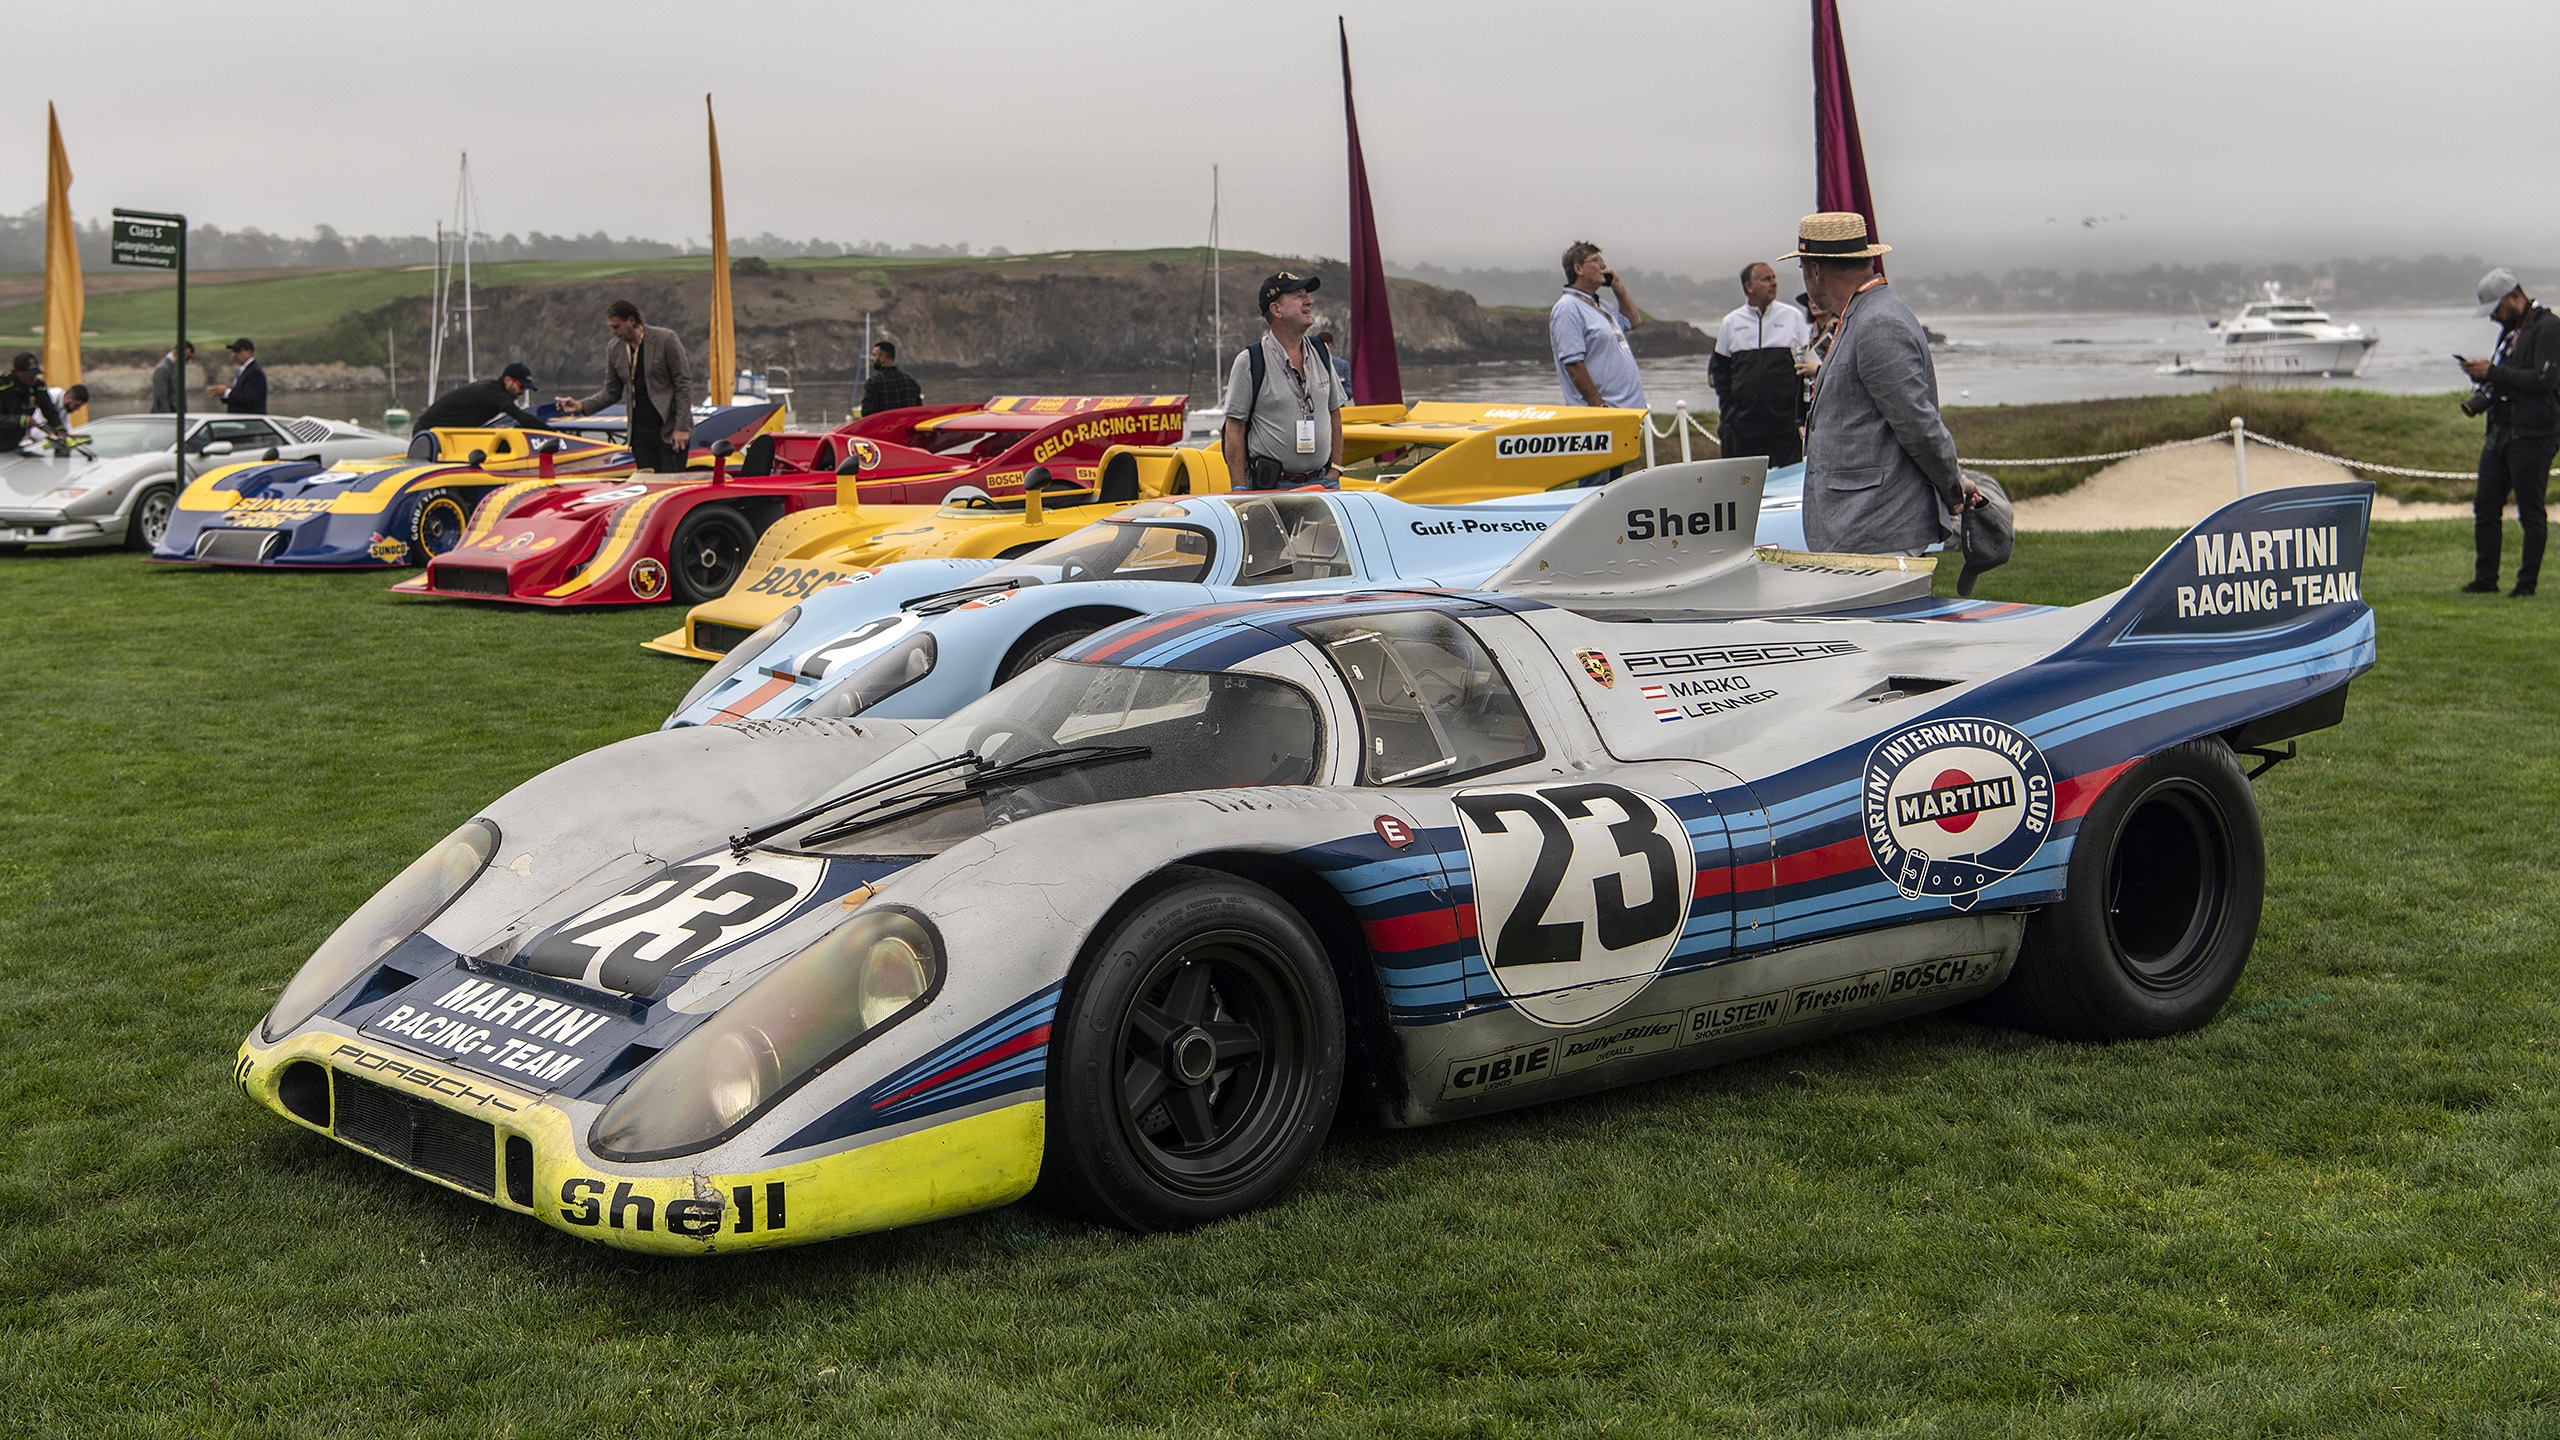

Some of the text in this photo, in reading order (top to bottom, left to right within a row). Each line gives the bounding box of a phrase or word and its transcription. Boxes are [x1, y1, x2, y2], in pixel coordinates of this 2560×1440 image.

[128, 224, 154, 238] Class
[1033, 413, 1182, 464] GELO-RACING-TEAM
[1499, 434, 1609, 455] GOODYEAR
[988, 473, 1023, 486] BOSCH
[232, 498, 336, 511] SUNOCO
[1410, 519, 1547, 536] Gulf-Porsche
[1627, 501, 1736, 540] Shell
[372, 543, 406, 556] SUNOCO
[2195, 526, 2338, 576] MARTINI
[1784, 564, 1883, 577] Shell
[2177, 571, 2359, 619] RACING-TEAM
[800, 617, 903, 680] 2
[1622, 643, 1867, 671] PORSCHE
[1669, 675, 1752, 698] MARKO
[1682, 689, 1780, 719] LENNEP
[1868, 723, 2048, 865] MARTINI INTERNATIONAL CLUB
[1900, 780, 2011, 823] MARTINI
[1381, 821, 1407, 842] E
[1451, 783, 1682, 968] 23
[528, 864, 798, 999] 23
[1889, 959, 1968, 994] BOSCH
[1917, 983, 1952, 995] ELECTRIC
[432, 978, 611, 1048] MARTINI
[1794, 980, 1880, 1016] Firestone
[1821, 1006, 1842, 1016] TIRES
[1692, 999, 1779, 1032] BILSTEIN
[1695, 1019, 1768, 1041] SHOCK ABSORBERS
[376, 1004, 584, 1082] RACING-TEAM
[1596, 1045, 1634, 1063] OVERALLS
[1484, 1079, 1513, 1092] LIGHTS
[560, 1178, 786, 1236] Shell
